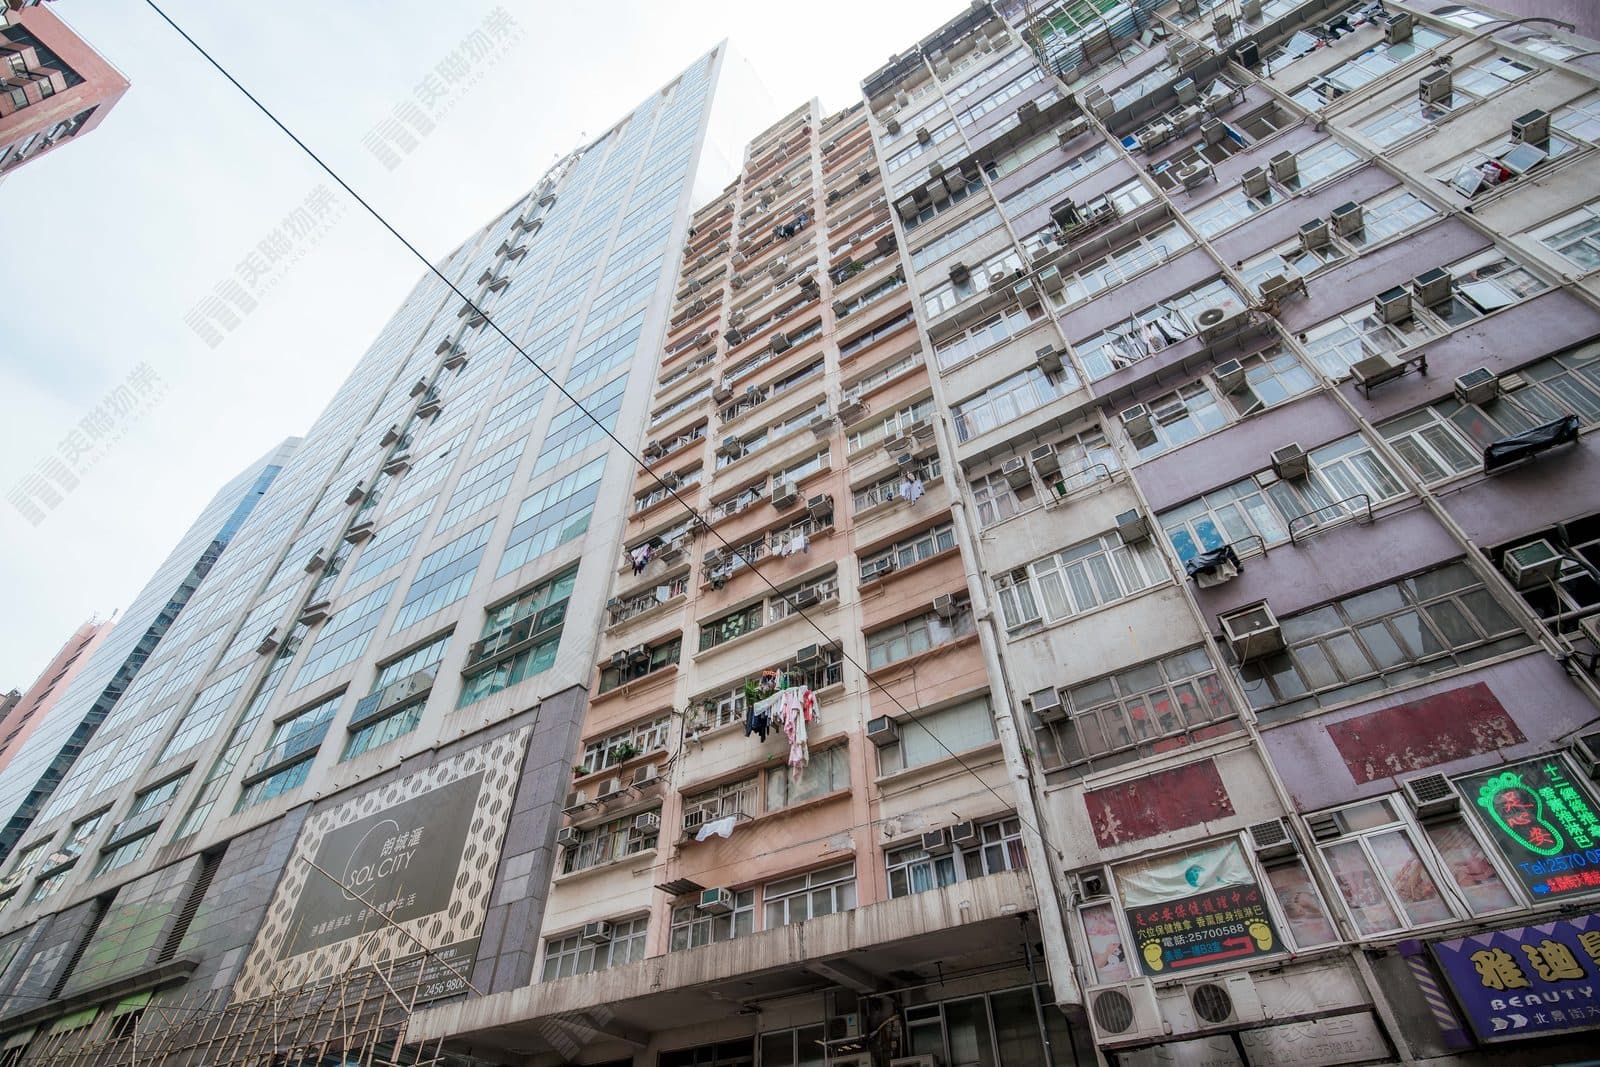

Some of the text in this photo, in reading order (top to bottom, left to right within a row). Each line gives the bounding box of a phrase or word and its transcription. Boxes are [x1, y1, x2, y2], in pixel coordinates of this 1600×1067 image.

[347, 849, 416, 889] SOL CITY
[1162, 924, 1245, 948] 電話:25700588
[425, 981, 445, 995] 2456
[1490, 986, 1593, 1011] BEAUTY
